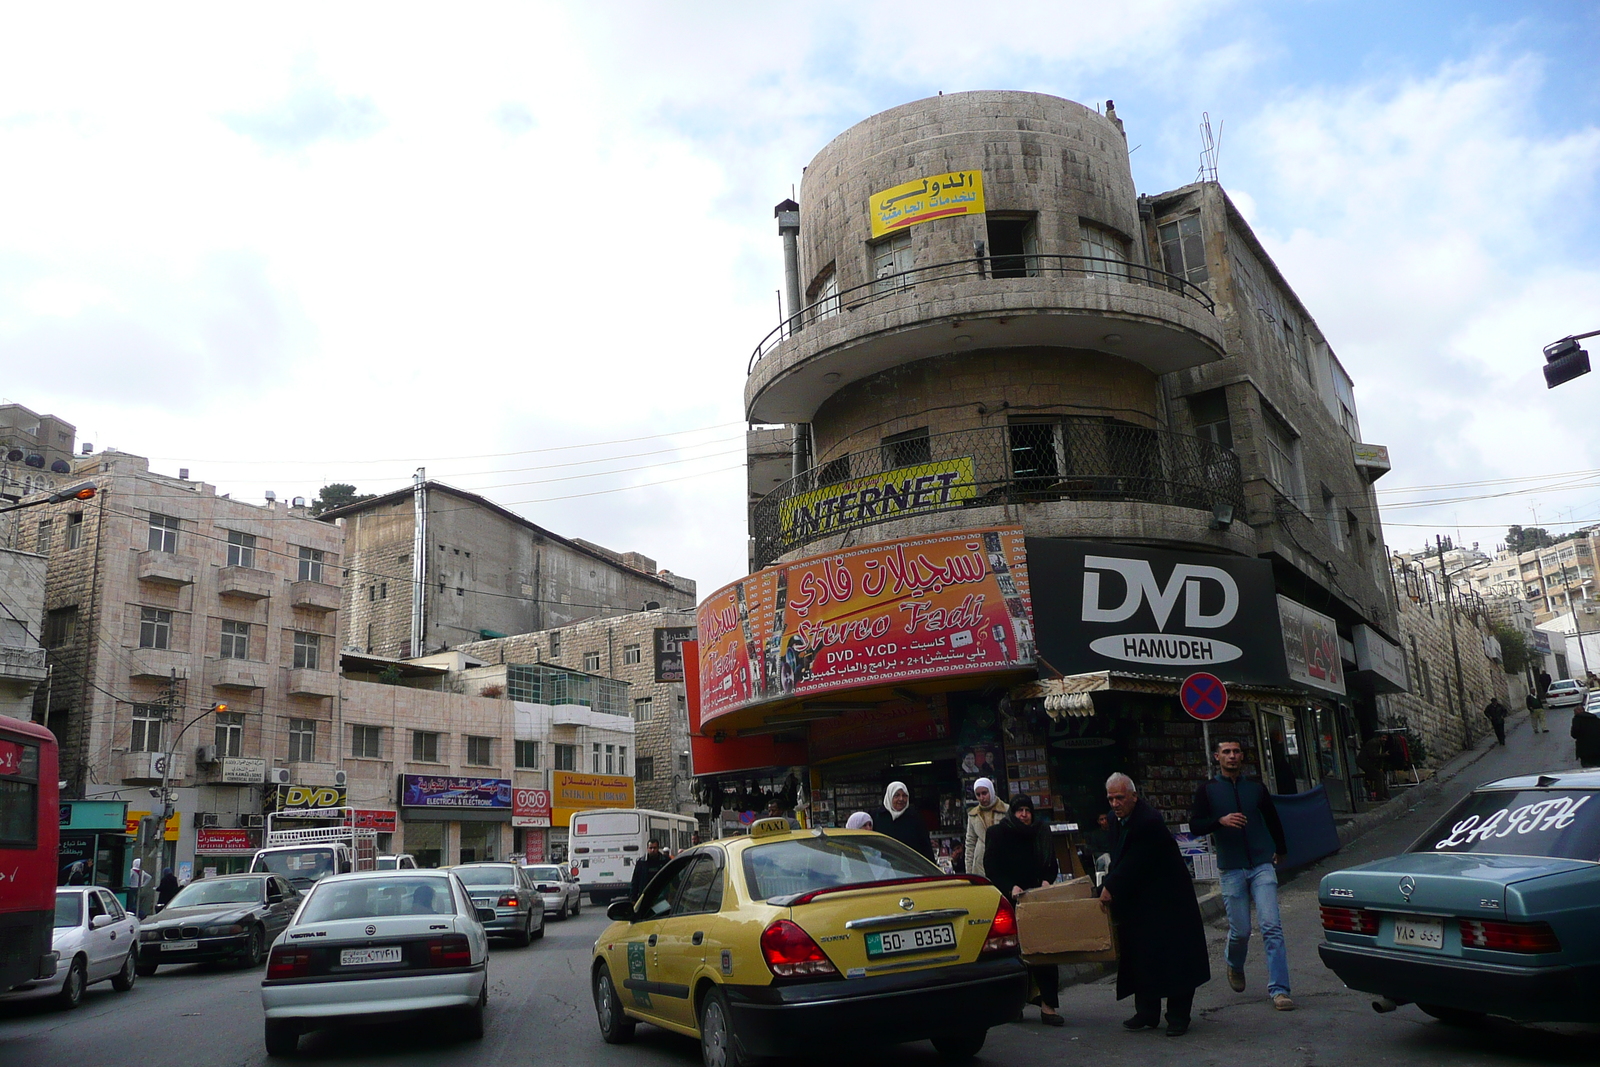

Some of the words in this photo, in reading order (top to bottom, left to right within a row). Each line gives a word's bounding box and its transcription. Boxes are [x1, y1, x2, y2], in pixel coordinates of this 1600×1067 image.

[880, 172, 973, 211] الدولي
[929, 192, 976, 208] للخدمات
[792, 472, 958, 534] INTERNET
[862, 543, 986, 597] تسجيلات
[789, 557, 853, 616] فادي
[1081, 554, 1240, 633] DVD
[794, 614, 890, 652] Stereo
[899, 594, 986, 634] Fadi
[827, 650, 854, 664] DVD
[865, 643, 897, 657] V.CD
[910, 636, 946, 650] كاسيت
[966, 647, 986, 662] بلي
[1123, 638, 1214, 661] HAMUDEH
[800, 666, 836, 683] كمبيوتر
[838, 662, 867, 677] والعاب
[869, 659, 897, 673] برامج
[600, 778, 628, 788] مكتبة
[286, 787, 339, 807] DVD
[517, 790, 546, 808] TNT
[562, 788, 596, 800] ISTIKLAL
[598, 791, 627, 801] LIBRARY
[759, 820, 784, 832] TAXI
[1435, 795, 1591, 850] LAITH
[820, 932, 851, 943] SUNNY
[914, 928, 951, 946] 8353
